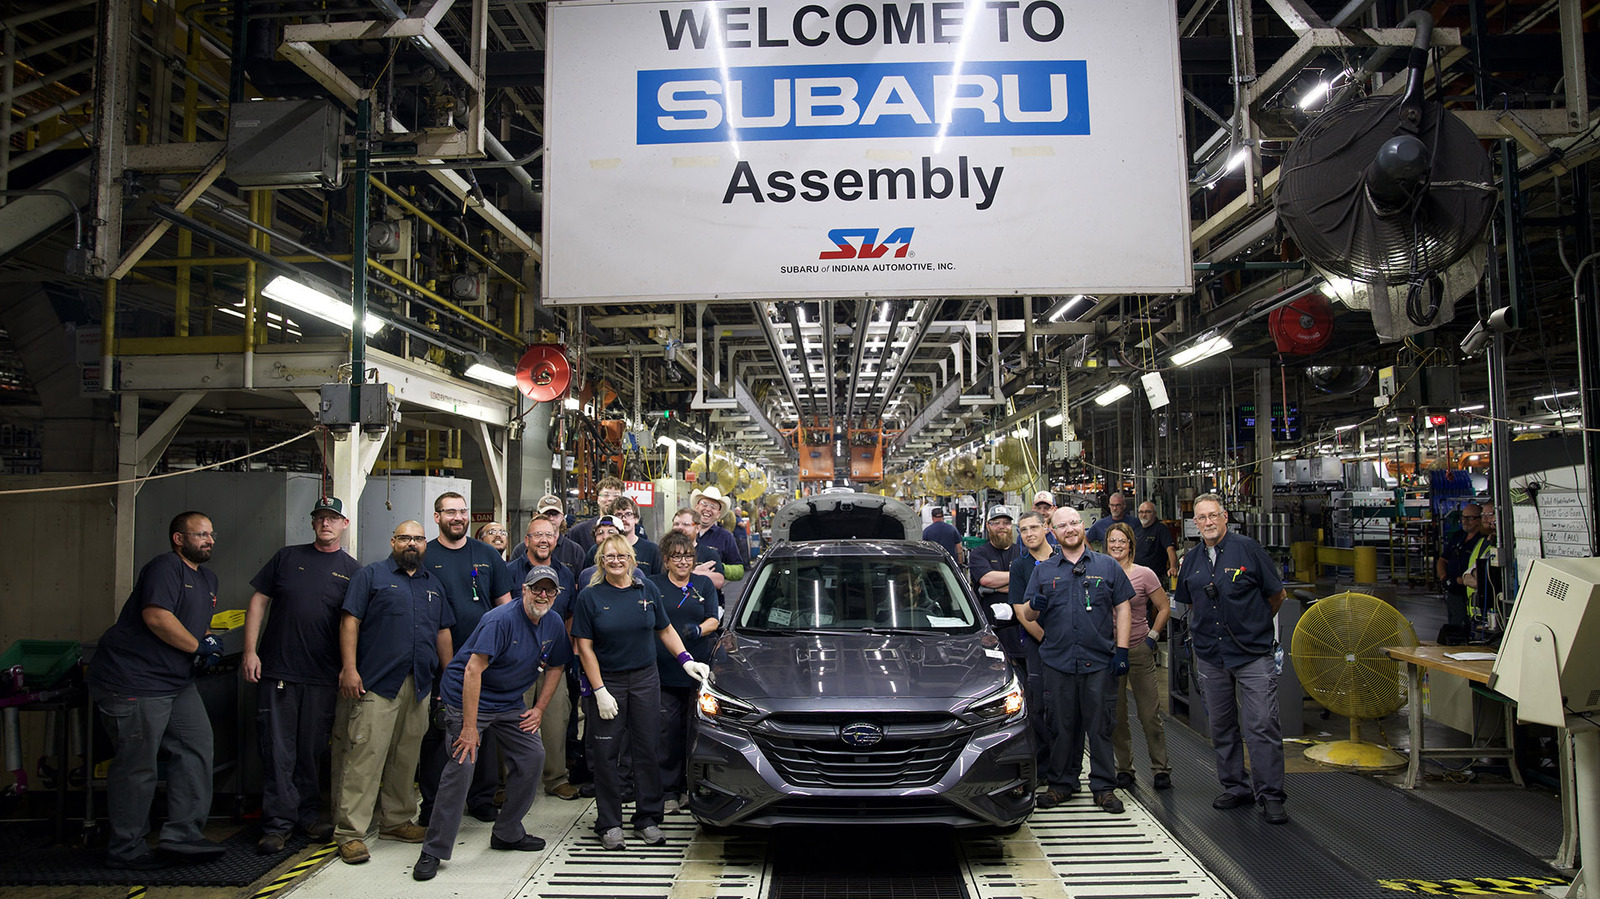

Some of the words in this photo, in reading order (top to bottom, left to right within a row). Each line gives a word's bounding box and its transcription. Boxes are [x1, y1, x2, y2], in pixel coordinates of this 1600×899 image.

[660, 2, 966, 50] WELCOME
[995, 0, 1066, 43] TO
[656, 73, 1069, 132] SUBARU
[722, 156, 1005, 210] Assembly
[780, 265, 819, 274] SUBARU
[821, 264, 830, 273] of
[832, 264, 870, 273] INDIANA
[872, 263, 935, 272] AUTOMOTIVE,
[937, 262, 956, 271] INC.
